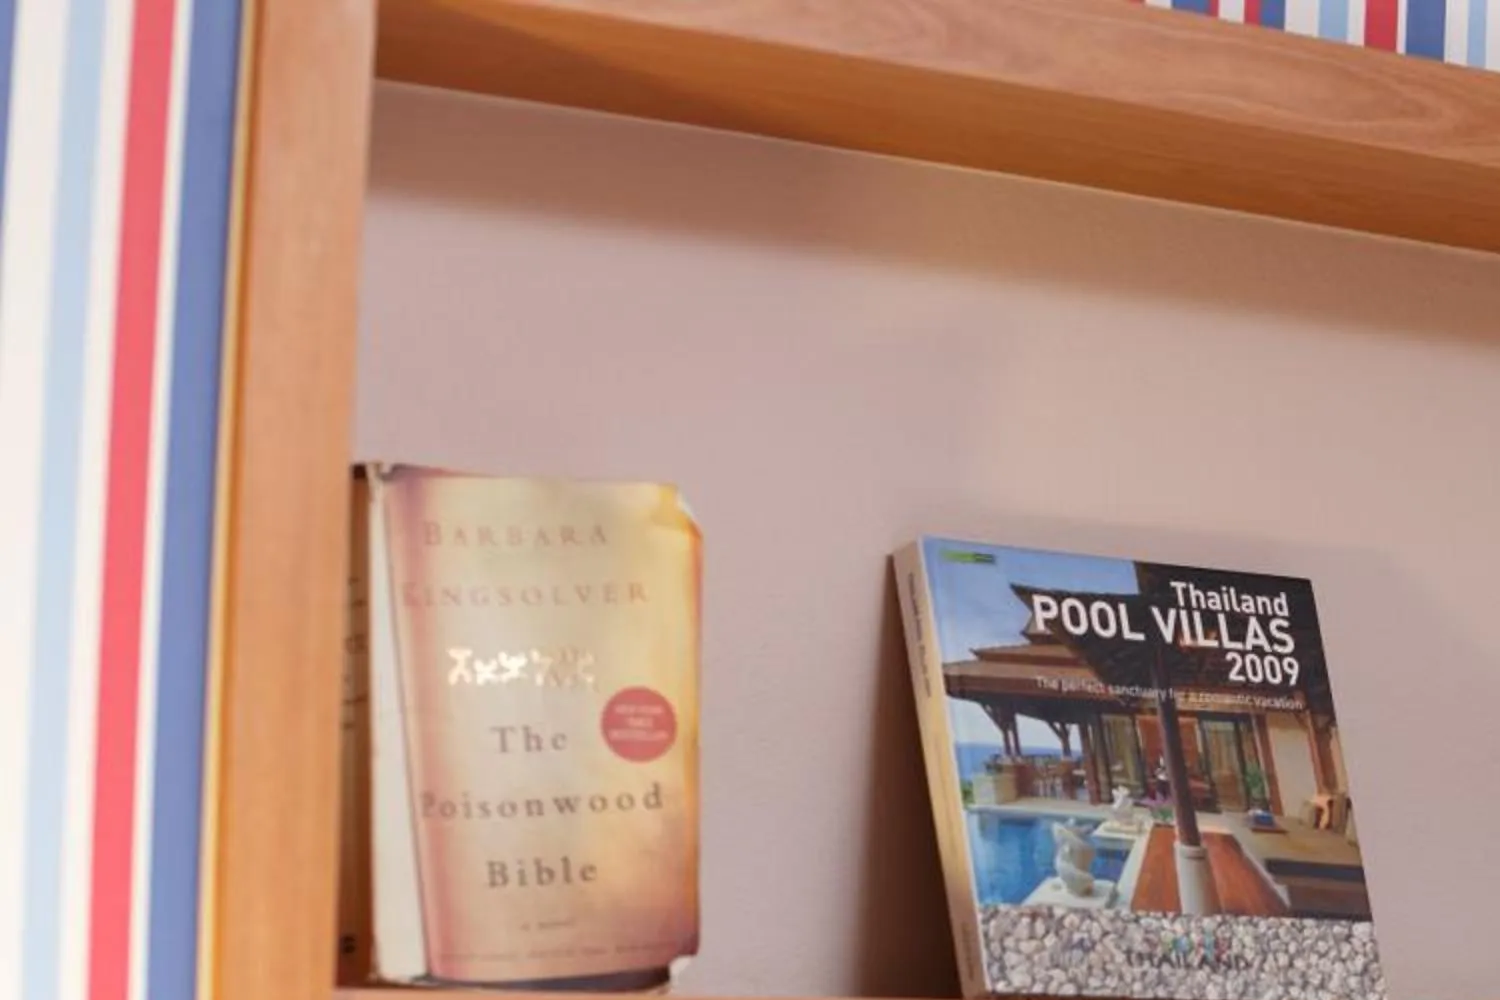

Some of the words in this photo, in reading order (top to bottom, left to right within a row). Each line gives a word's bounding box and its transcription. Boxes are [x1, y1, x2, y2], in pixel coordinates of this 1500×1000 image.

[424, 521, 607, 546] BARBARA
[403, 581, 647, 607] KINGSOLVER
[1170, 581, 1290, 617] Thailand
[1031, 594, 1146, 641] POOL
[1151, 606, 1296, 653] VILLAS
[1225, 652, 1300, 686] 2009
[1037, 676, 1058, 691] The
[1061, 679, 1105, 695] perfect
[1108, 683, 1167, 702] sanctuary
[1254, 694, 1303, 710] vacation
[489, 724, 568, 753] The
[420, 781, 663, 819] Poisonwood
[486, 856, 598, 888] Bible
